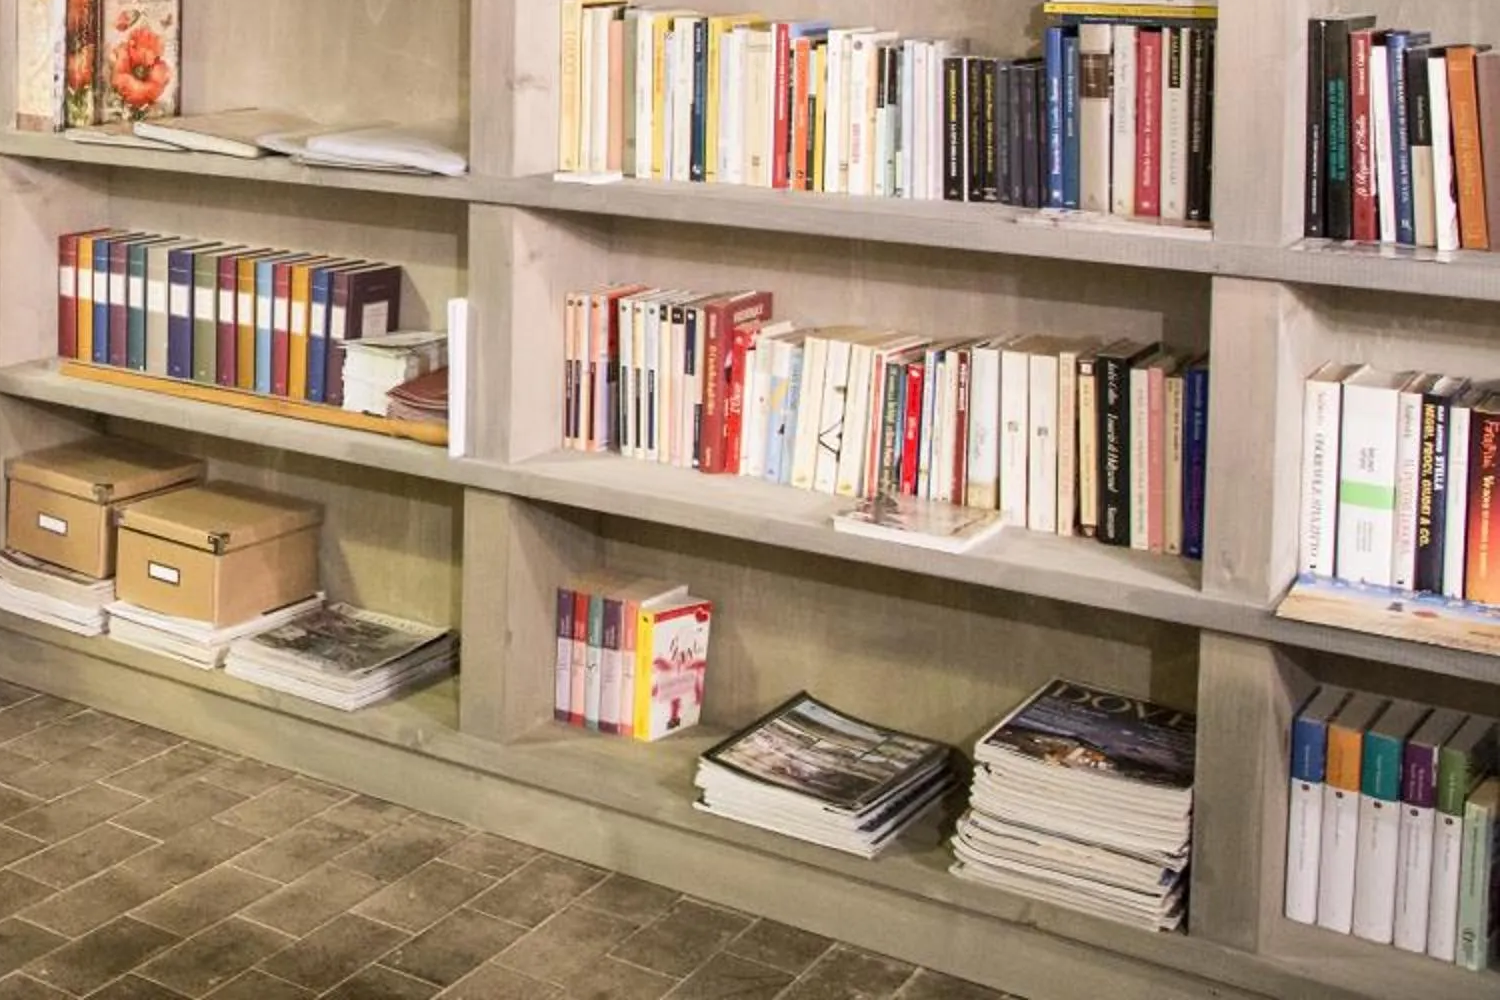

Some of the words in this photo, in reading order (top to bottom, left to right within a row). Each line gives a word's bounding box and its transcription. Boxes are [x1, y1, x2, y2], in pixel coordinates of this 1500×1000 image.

[1423, 403, 1435, 439] NEGRI,
[1433, 455, 1444, 491] STELLA
[1419, 528, 1431, 547] CO.
